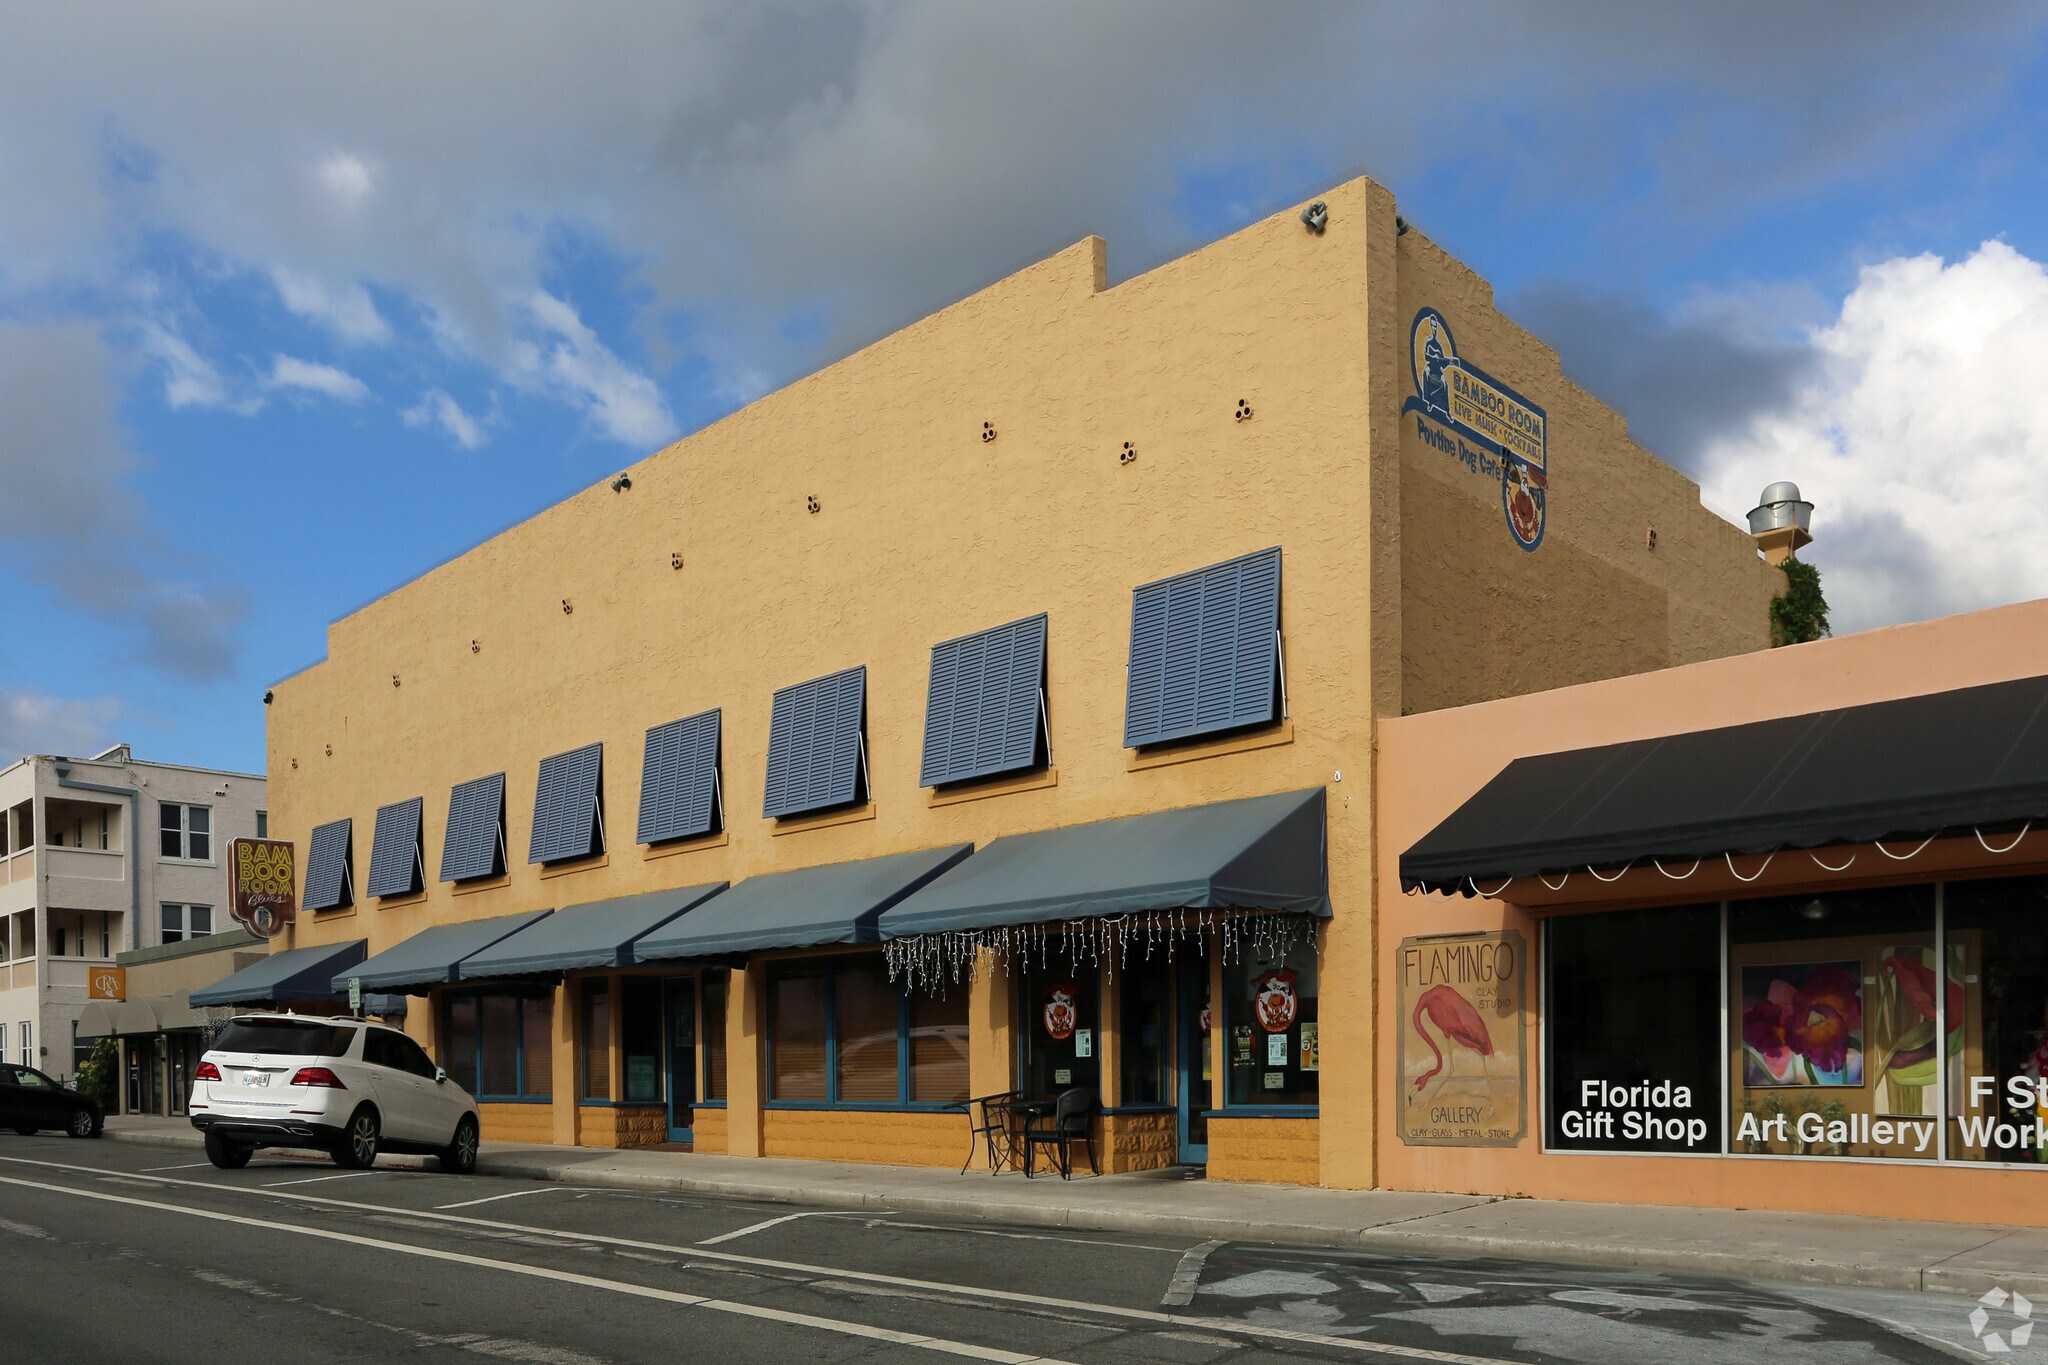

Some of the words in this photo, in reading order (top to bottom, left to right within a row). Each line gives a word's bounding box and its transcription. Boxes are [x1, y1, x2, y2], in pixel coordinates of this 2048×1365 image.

[1453, 371, 1505, 417] BAMBOO
[1508, 403, 1541, 440] ROOM
[1454, 401, 1472, 422] LIVE
[1416, 415, 1456, 457] Poutine
[1458, 439, 1477, 474] Dog
[238, 843, 292, 865] BAM
[240, 860, 291, 883] BOO
[239, 879, 293, 897] ROOM
[247, 894, 286, 906] Blues
[1405, 943, 1513, 987] FLAMINGO
[1476, 986, 1498, 997] CLAY
[1477, 998, 1511, 1010] STUDIO
[1581, 1080, 1692, 1108] Florida
[1970, 1076, 1995, 1108] F
[1430, 1107, 1483, 1124] GALLERY
[1411, 1129, 1428, 1137] CLAY
[1432, 1129, 1453, 1138] GLASS
[1459, 1129, 1483, 1138] METAL
[1488, 1129, 1511, 1138] STONE
[1561, 1111, 1615, 1139] Gift
[1622, 1112, 1707, 1146] Shop
[1736, 1113, 1788, 1142] Art
[1797, 1113, 1935, 1152] Gallery
